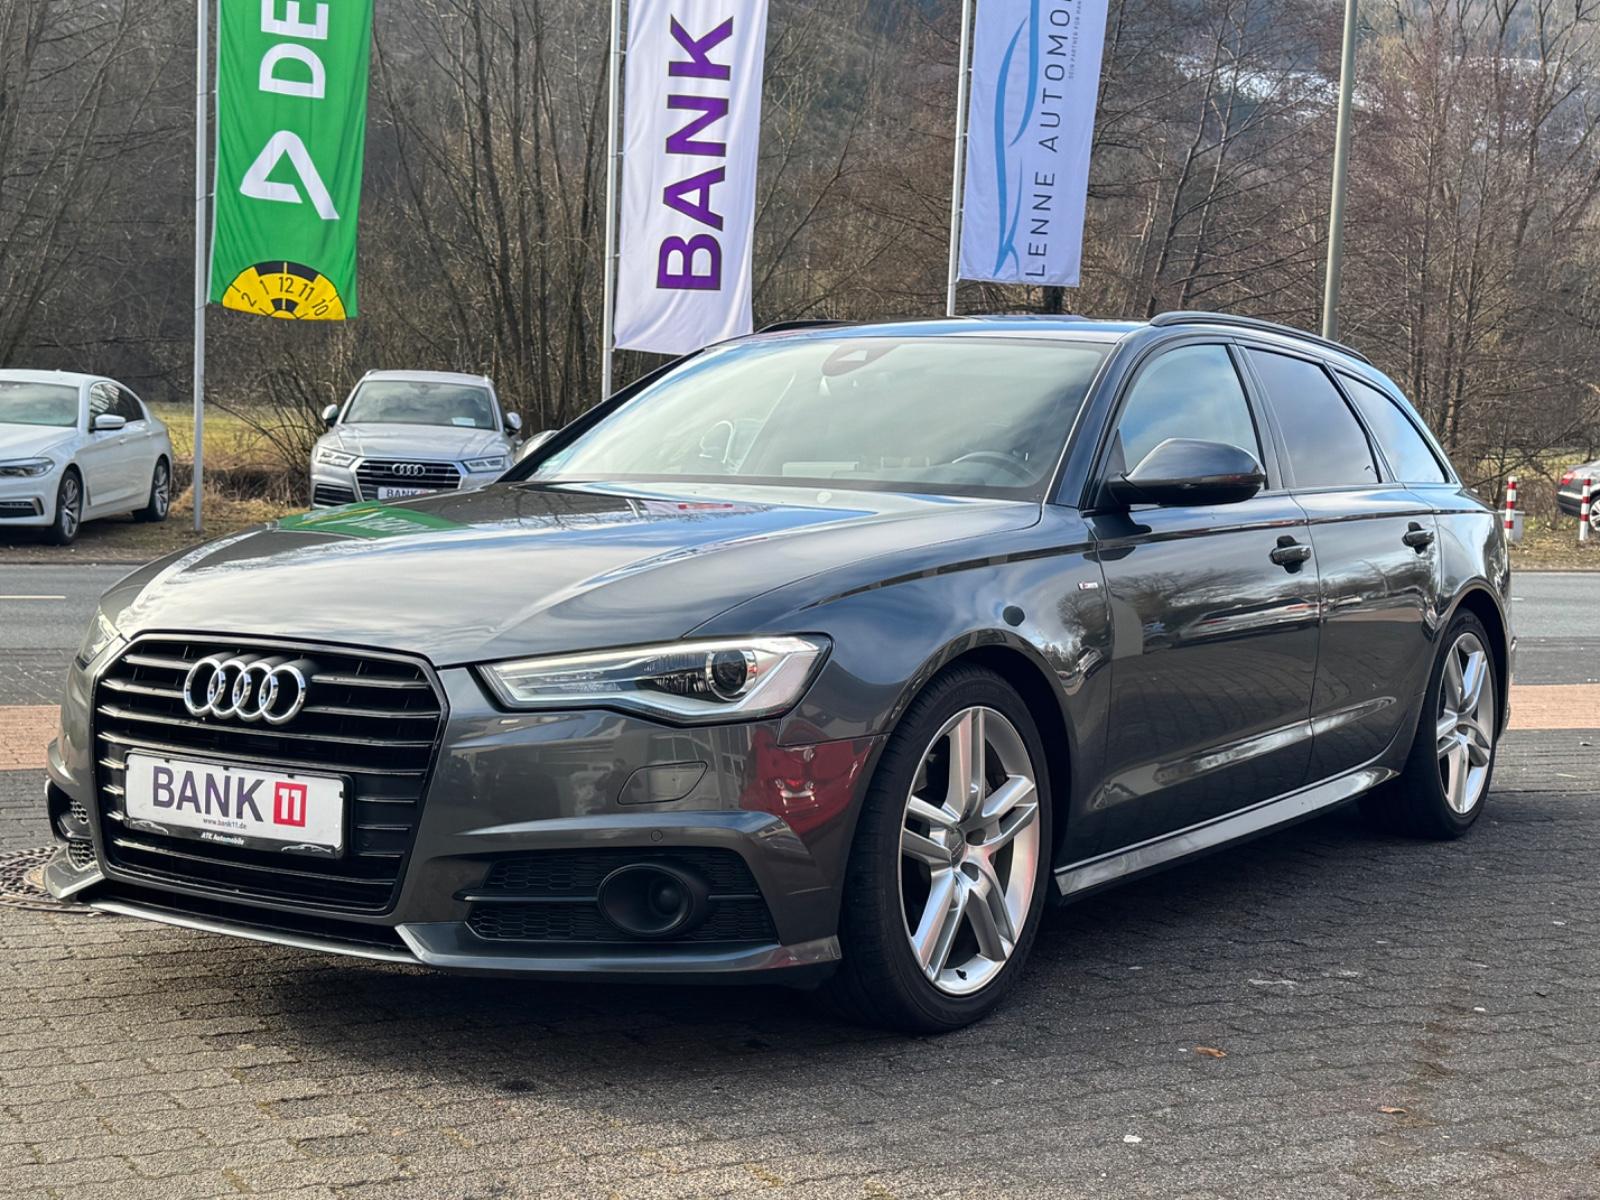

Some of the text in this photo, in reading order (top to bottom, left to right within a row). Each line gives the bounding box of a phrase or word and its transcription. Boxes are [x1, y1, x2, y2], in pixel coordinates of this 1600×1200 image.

[656, 14, 734, 290] BANK
[1025, 0, 1072, 278] LENNE AUTOMO
[241, 277, 329, 316] 2 1 12 11 10
[153, 766, 302, 822] BANK 11
[203, 818, 247, 829] www.bank11.de
